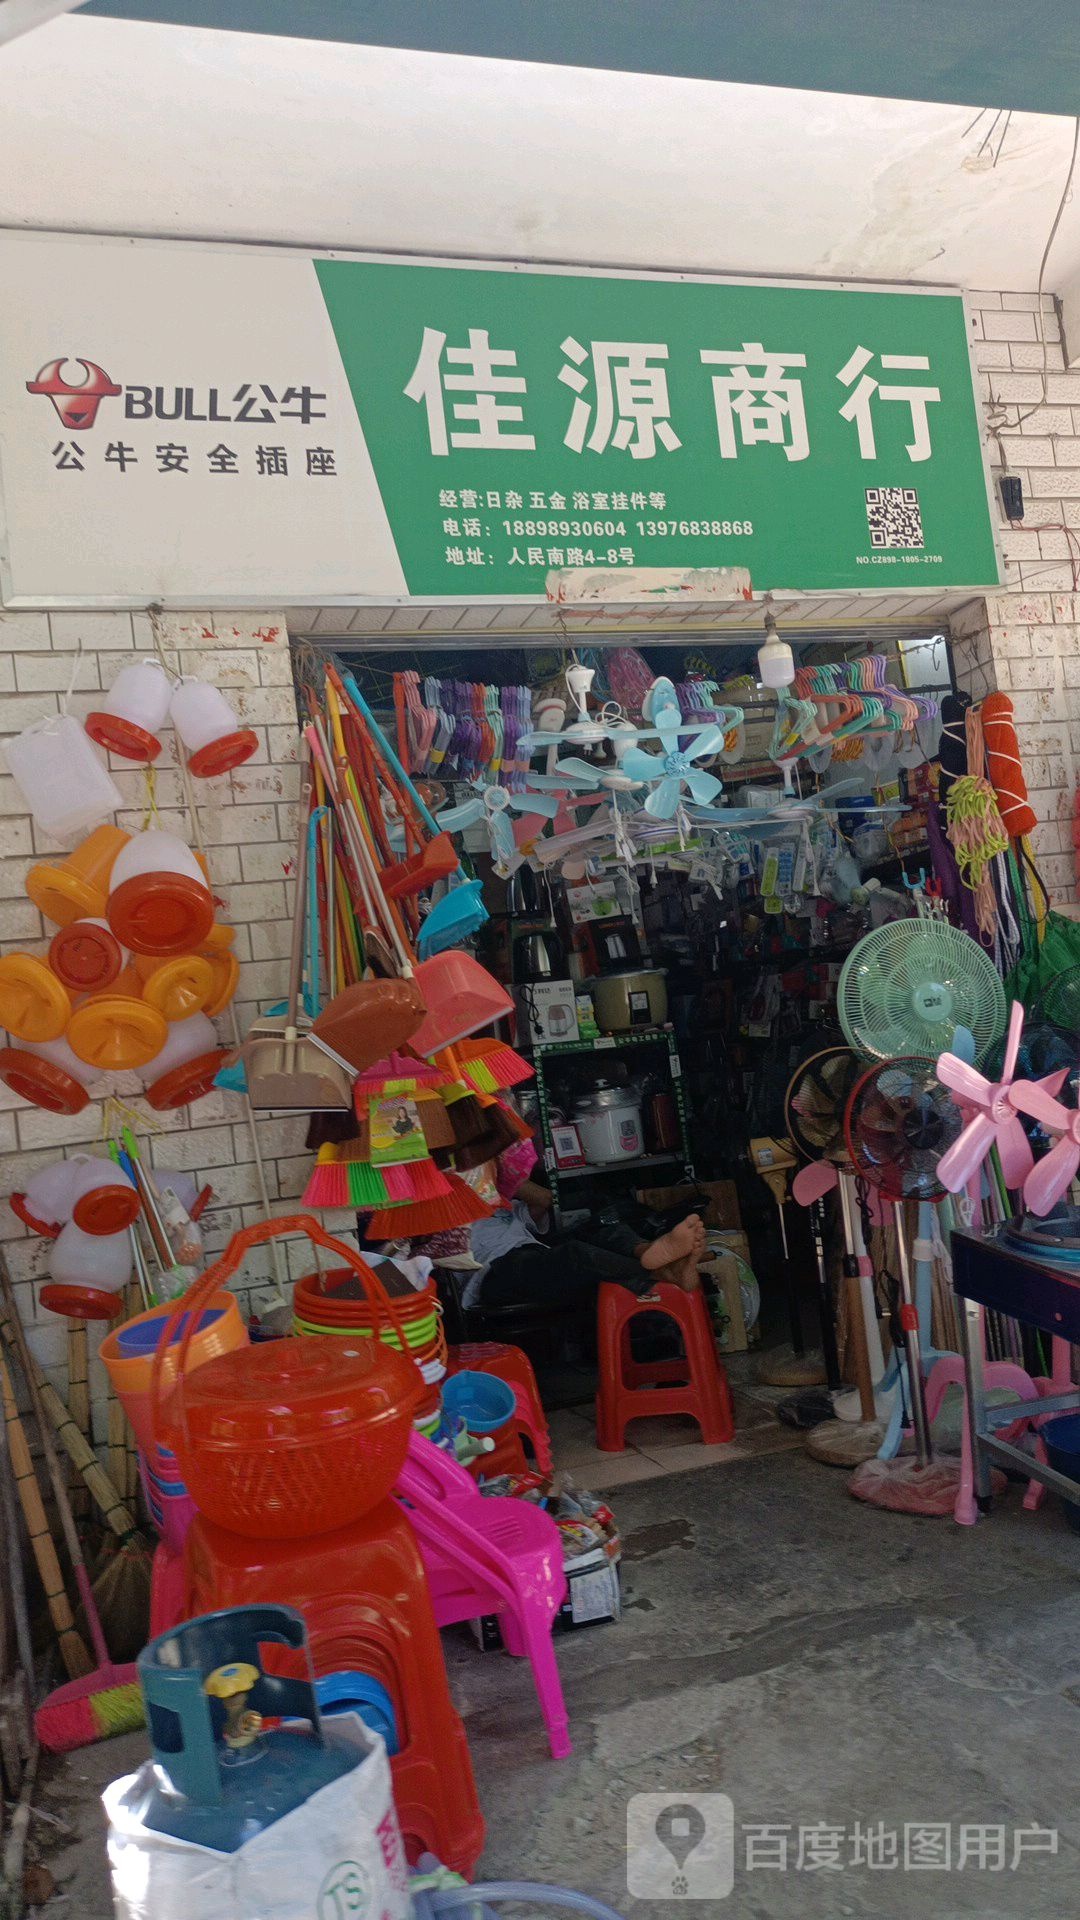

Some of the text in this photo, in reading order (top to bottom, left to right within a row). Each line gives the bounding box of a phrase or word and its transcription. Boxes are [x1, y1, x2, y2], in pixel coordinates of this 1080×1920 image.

[403, 326, 942, 464] 佳源商行
[51, 440, 338, 476] 公牛安全插座
[529, 490, 567, 511] 五金
[572, 490, 667, 512] 浴室挂件等
[635, 520, 754, 537] 13976838868
